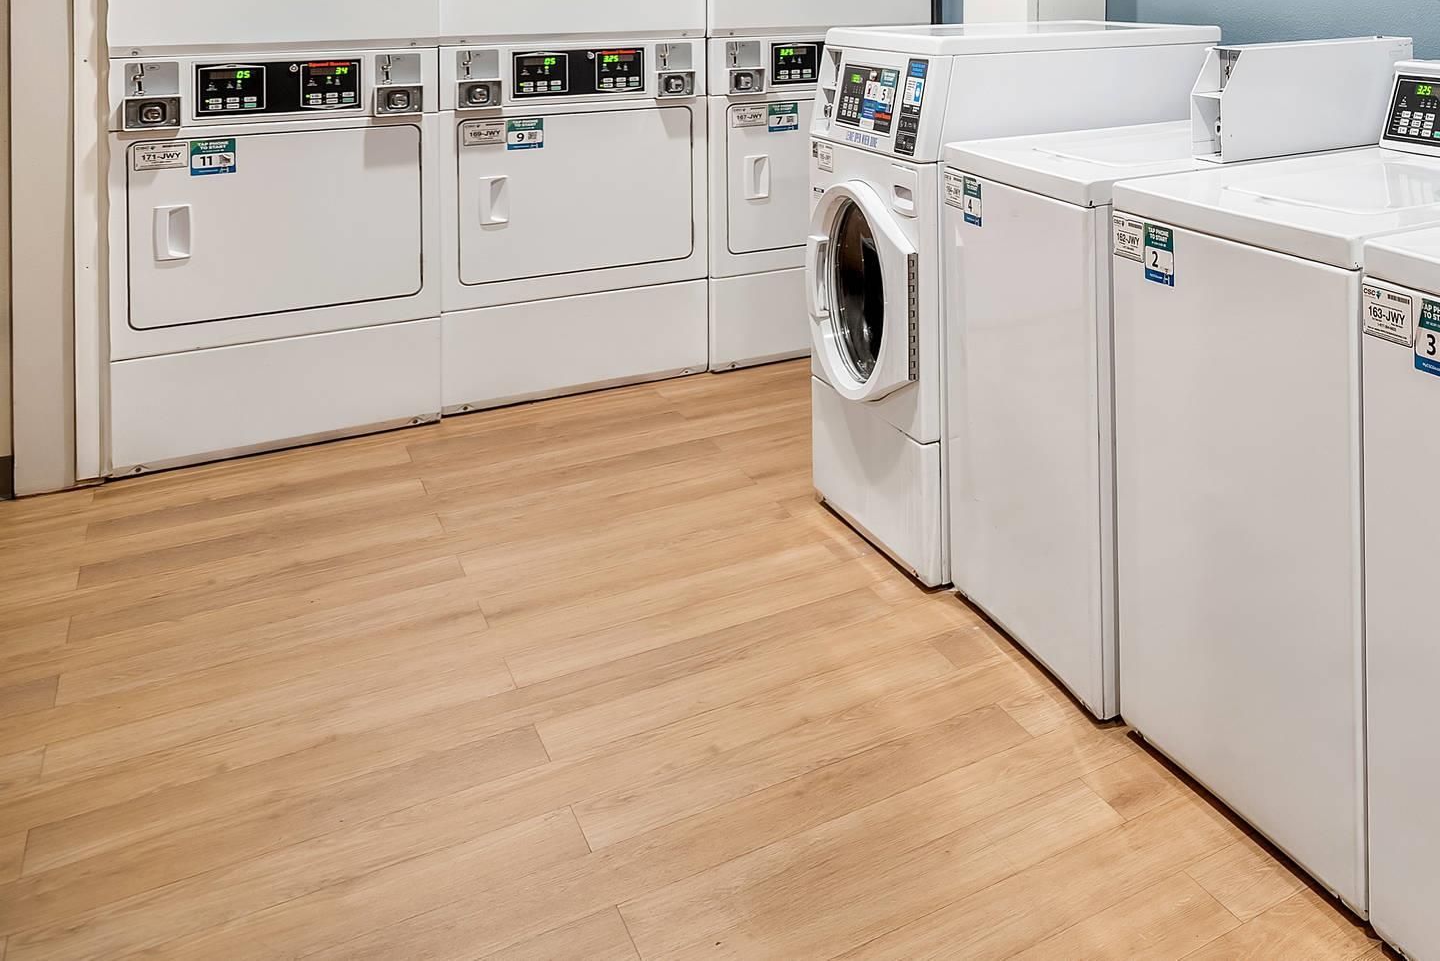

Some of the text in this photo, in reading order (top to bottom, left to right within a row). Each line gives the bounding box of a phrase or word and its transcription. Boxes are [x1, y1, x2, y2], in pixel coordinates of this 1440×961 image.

[236, 70, 250, 79] 05
[335, 67, 348, 75] 34
[776, 116, 783, 125] 7
[516, 133, 524, 142] 9
[141, 152, 181, 161] 171-JWY
[200, 156, 212, 166] 11
[1152, 251, 1158, 267] 2
[1363, 287, 1376, 296] CSC
[1368, 305, 1405, 325] 163-JWY
[1423, 311, 1431, 319] TO
[1426, 334, 1436, 356] 3
